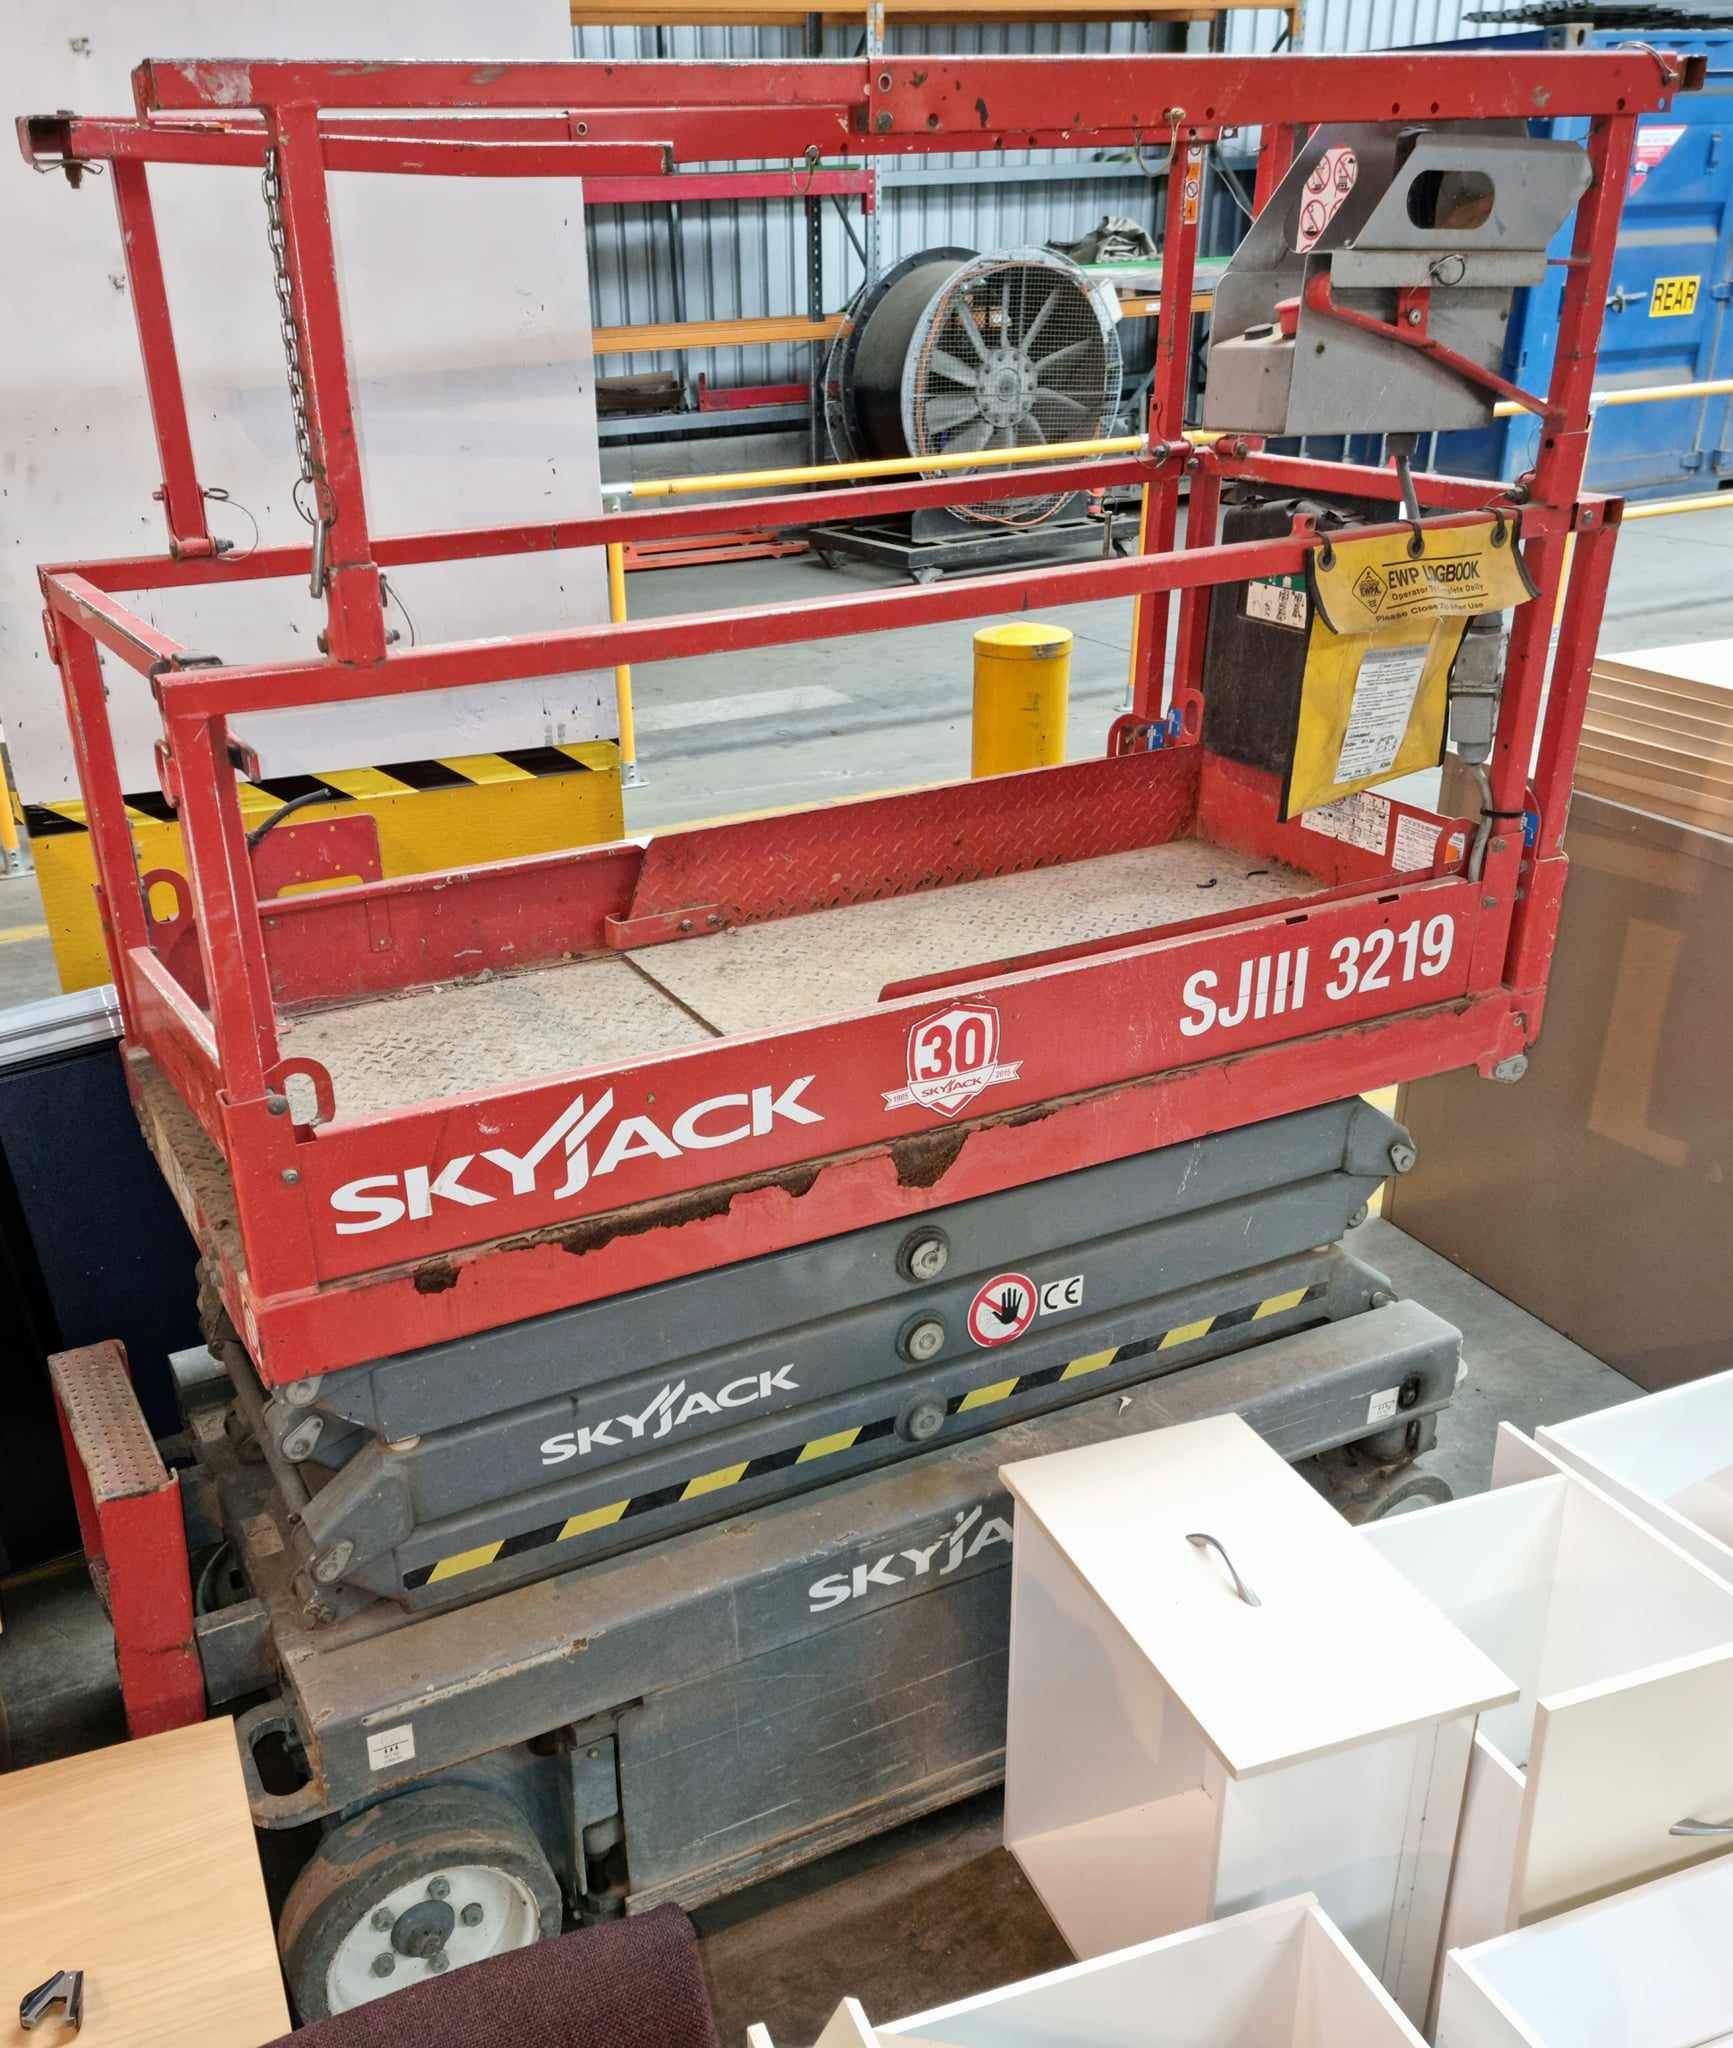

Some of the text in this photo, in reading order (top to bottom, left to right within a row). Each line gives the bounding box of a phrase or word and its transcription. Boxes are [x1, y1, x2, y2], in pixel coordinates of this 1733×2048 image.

[1652, 280, 1697, 312] REAR
[1388, 560, 1481, 590] EWP LOGBOOK
[1391, 587, 1429, 601] Operator
[1375, 611, 1408, 623] Please
[1410, 603, 1438, 614] Close
[1467, 601, 1484, 610] Use
[1325, 913, 1455, 1001] 3219
[920, 1016, 986, 1081] 30
[920, 1076, 982, 1098] SKYJACK
[330, 1074, 825, 1236] SKYJACK
[1043, 1278, 1081, 1310] CE
[539, 1362, 801, 1466] SKYJACK
